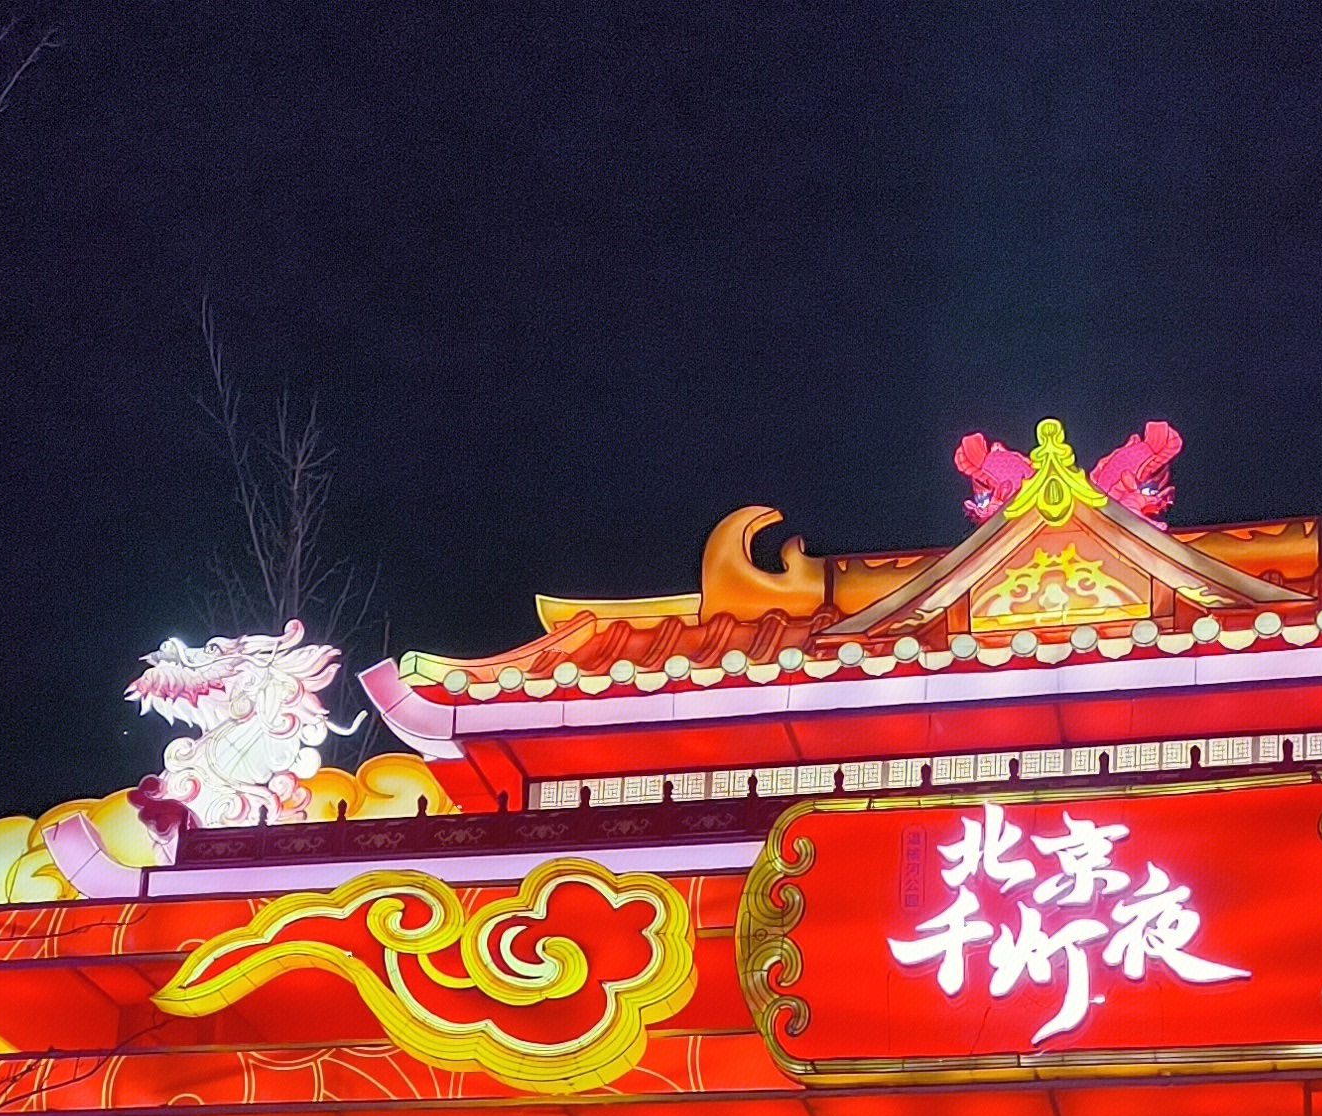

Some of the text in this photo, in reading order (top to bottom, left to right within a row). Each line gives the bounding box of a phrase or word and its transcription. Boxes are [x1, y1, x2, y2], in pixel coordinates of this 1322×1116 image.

[938, 800, 1131, 907] 北京
[886, 861, 1253, 1047] 千灯夜
